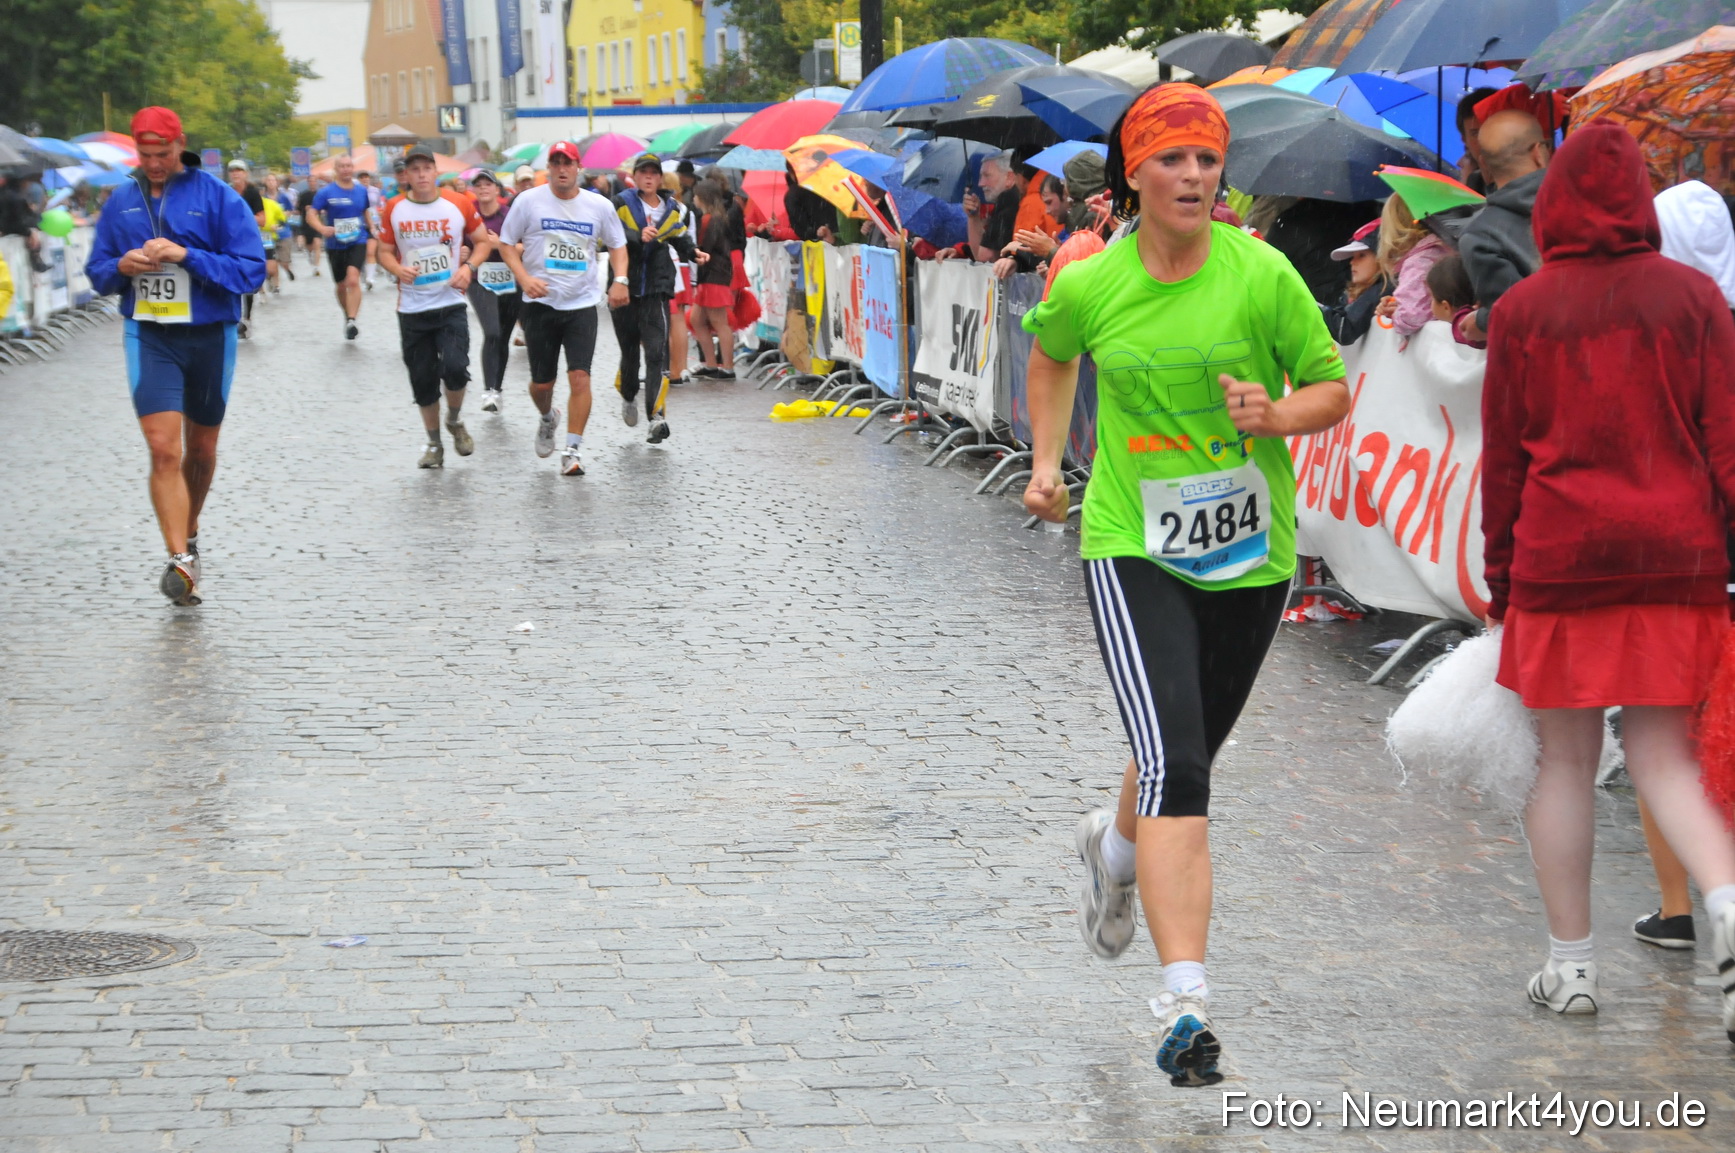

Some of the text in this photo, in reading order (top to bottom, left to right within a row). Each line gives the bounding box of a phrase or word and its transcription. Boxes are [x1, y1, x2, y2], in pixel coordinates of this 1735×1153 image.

[398, 218, 451, 232] MERZ
[482, 270, 511, 283] 2938
[1128, 434, 1194, 454] MERZ
[1181, 478, 1233, 498] BOCK
[1160, 493, 1260, 555] 2484
[1191, 552, 1229, 572] Anita
